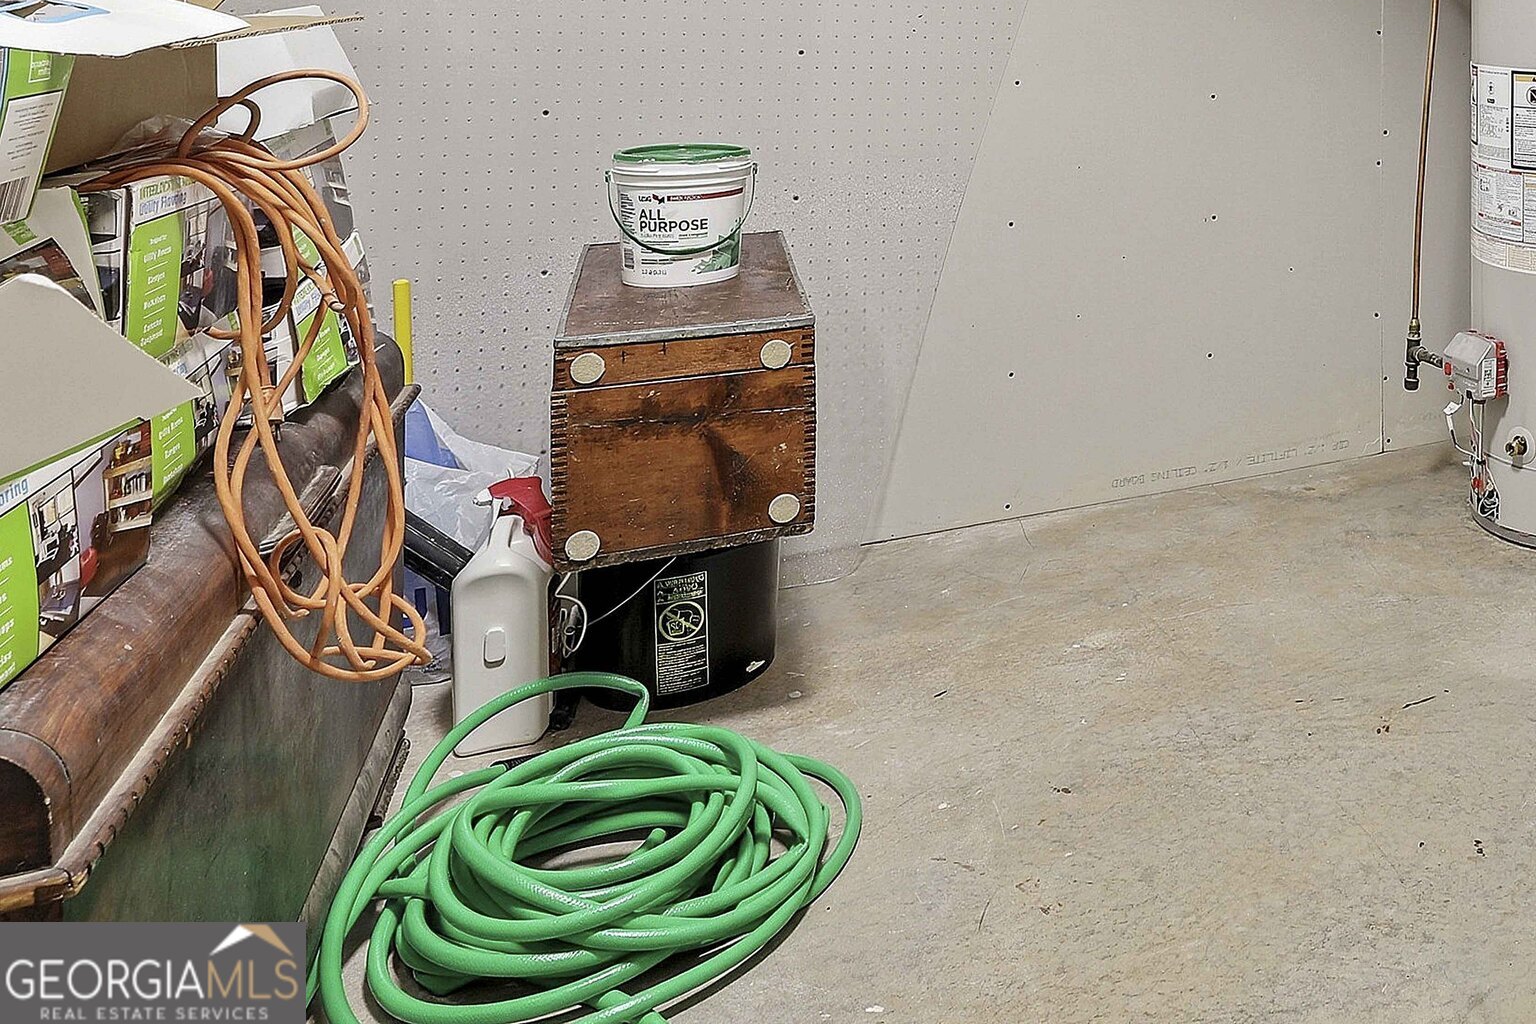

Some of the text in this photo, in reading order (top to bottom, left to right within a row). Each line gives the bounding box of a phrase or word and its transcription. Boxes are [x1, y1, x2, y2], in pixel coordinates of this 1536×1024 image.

[639, 208, 666, 221] ALL
[640, 218, 709, 233] PURPOSE
[0, 477, 29, 507] oring
